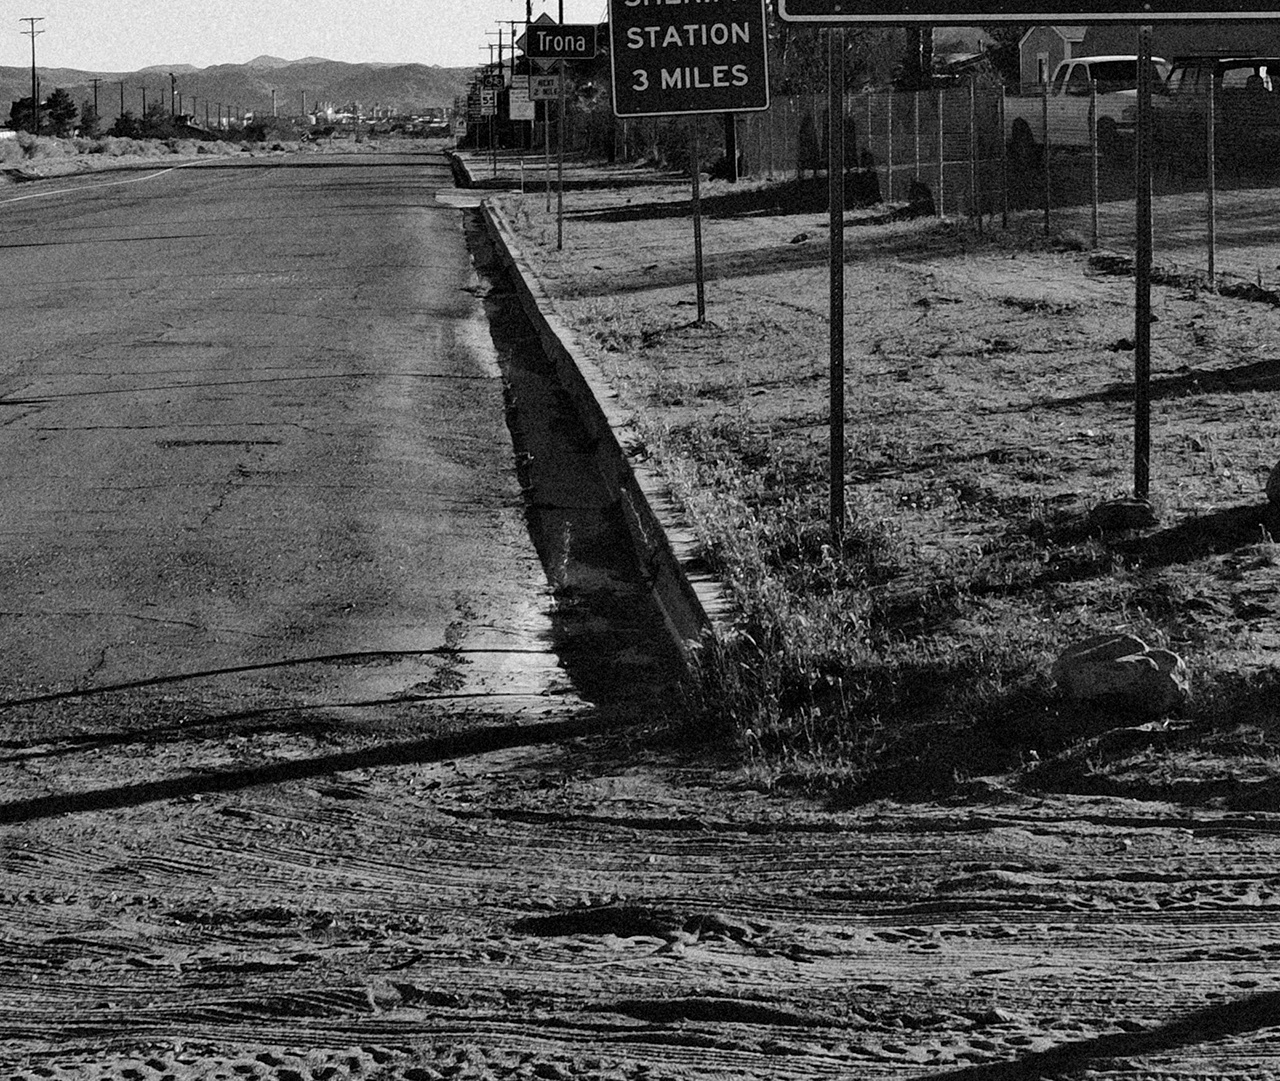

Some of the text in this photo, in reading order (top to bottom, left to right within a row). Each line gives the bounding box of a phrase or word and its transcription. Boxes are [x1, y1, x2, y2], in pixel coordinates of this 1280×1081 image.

[536, 30, 586, 52] Trona
[626, 21, 750, 50] STATION
[632, 63, 749, 92] 3 MILES
